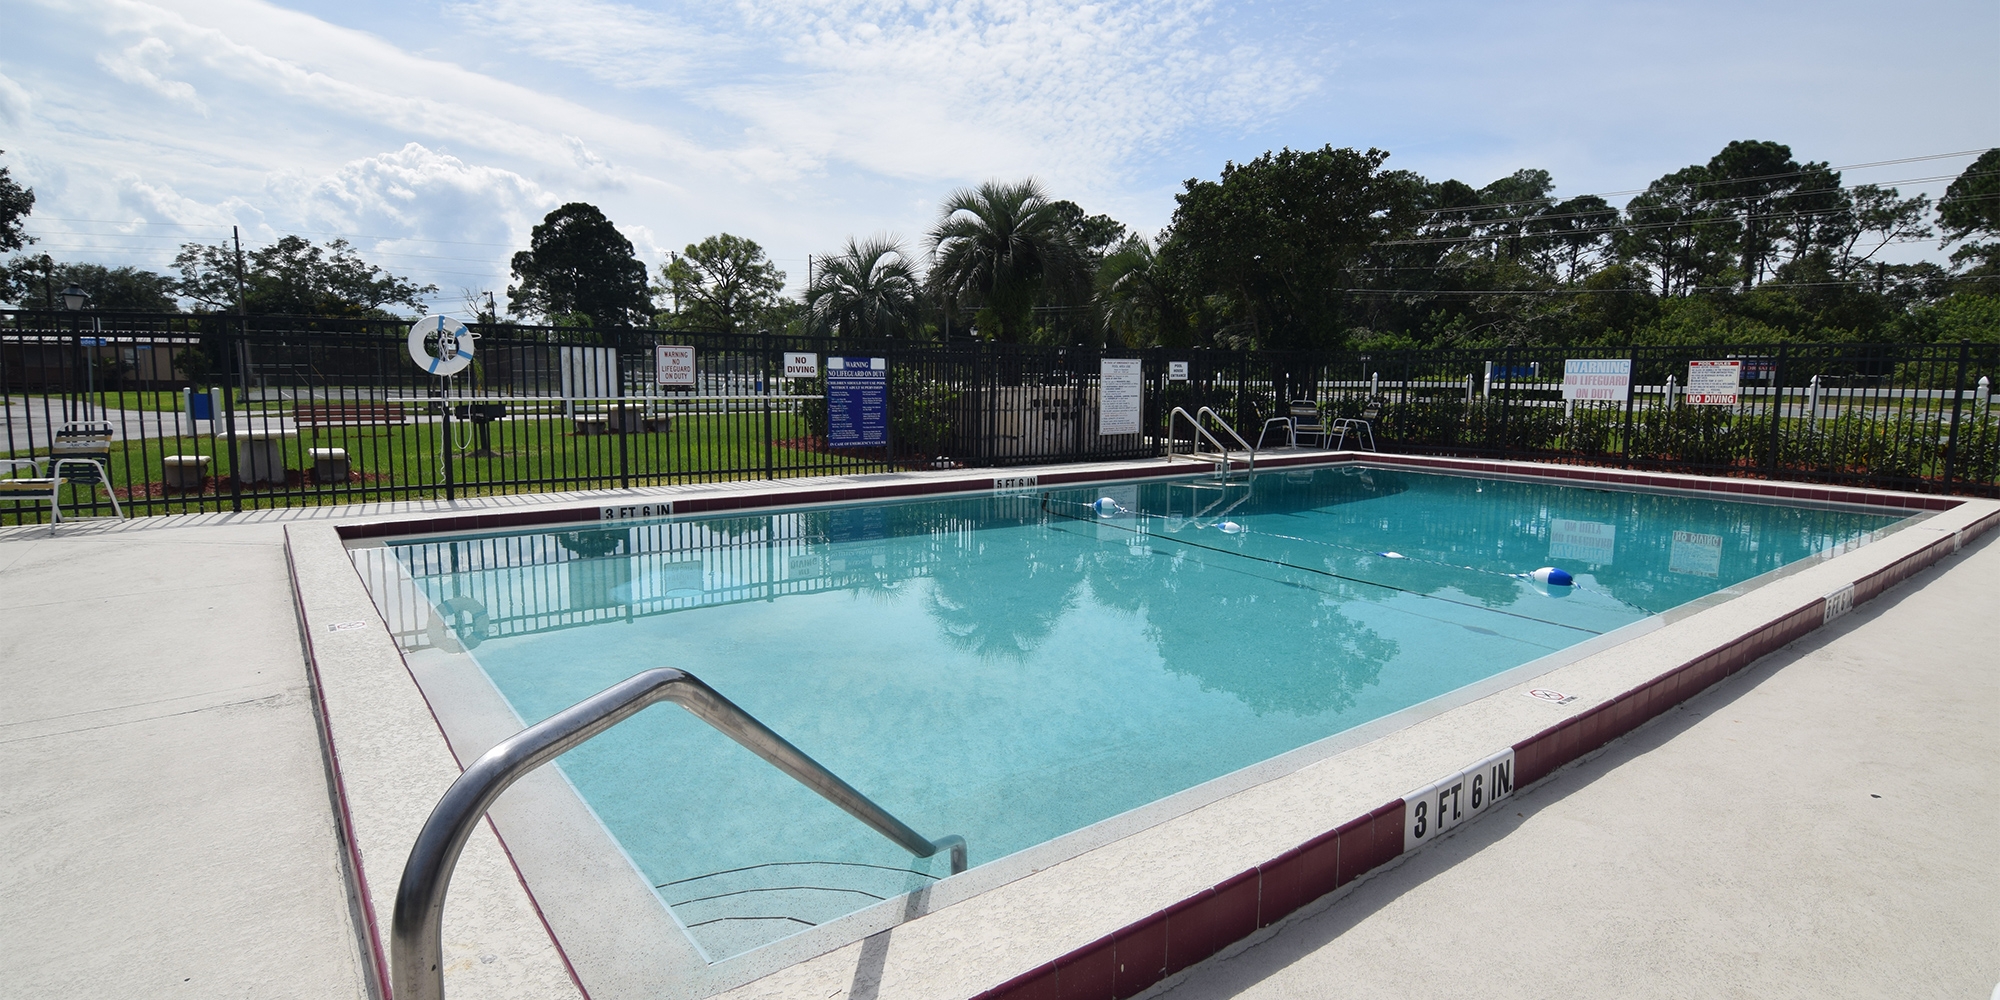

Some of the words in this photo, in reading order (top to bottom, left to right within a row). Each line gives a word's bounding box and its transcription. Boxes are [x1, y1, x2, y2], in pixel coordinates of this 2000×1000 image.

[846, 361, 869, 369] WARNING
[1567, 361, 1629, 374] WARNING
[1565, 375, 1578, 385] NO
[1580, 375, 1628, 386] LIFEGUARD
[1576, 388, 1588, 398] ON
[1591, 388, 1615, 399] DUTY
[1689, 395, 1702, 403] NO
[1705, 395, 1734, 404] DIVING
[997, 479, 1002, 488] 5
[1006, 479, 1015, 488] FT
[1019, 478, 1024, 487] 6
[1027, 477, 1035, 486] IN
[605, 508, 614, 519] 3
[620, 507, 636, 518] FT
[643, 505, 651, 516] 6
[657, 504, 670, 515] IN
[1414, 801, 1427, 839] 3
[1438, 783, 1462, 829] FT.
[1472, 774, 1483, 810] 6
[1491, 759, 1512, 801] IN.
